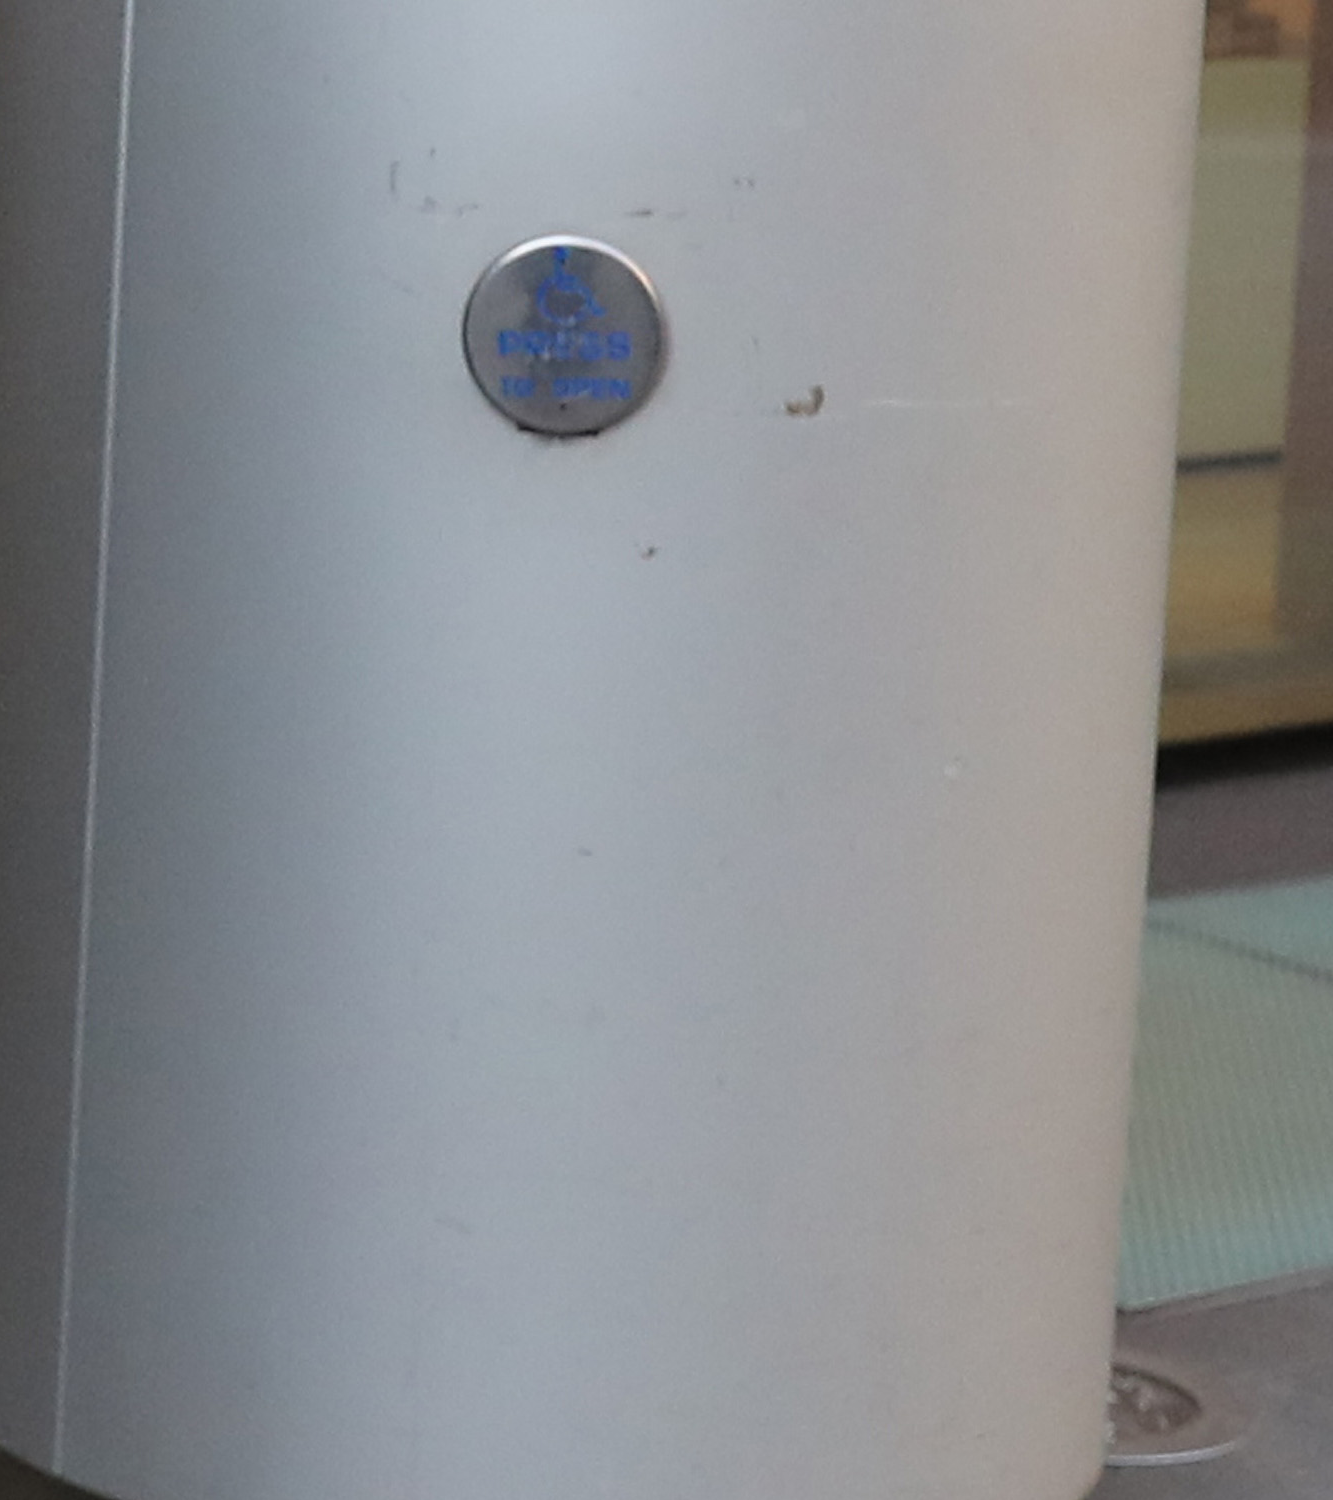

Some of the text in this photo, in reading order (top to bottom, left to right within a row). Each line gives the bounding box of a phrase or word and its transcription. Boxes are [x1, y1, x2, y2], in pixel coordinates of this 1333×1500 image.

[498, 330, 632, 361] PRESS
[502, 377, 631, 399] TO OPEN
